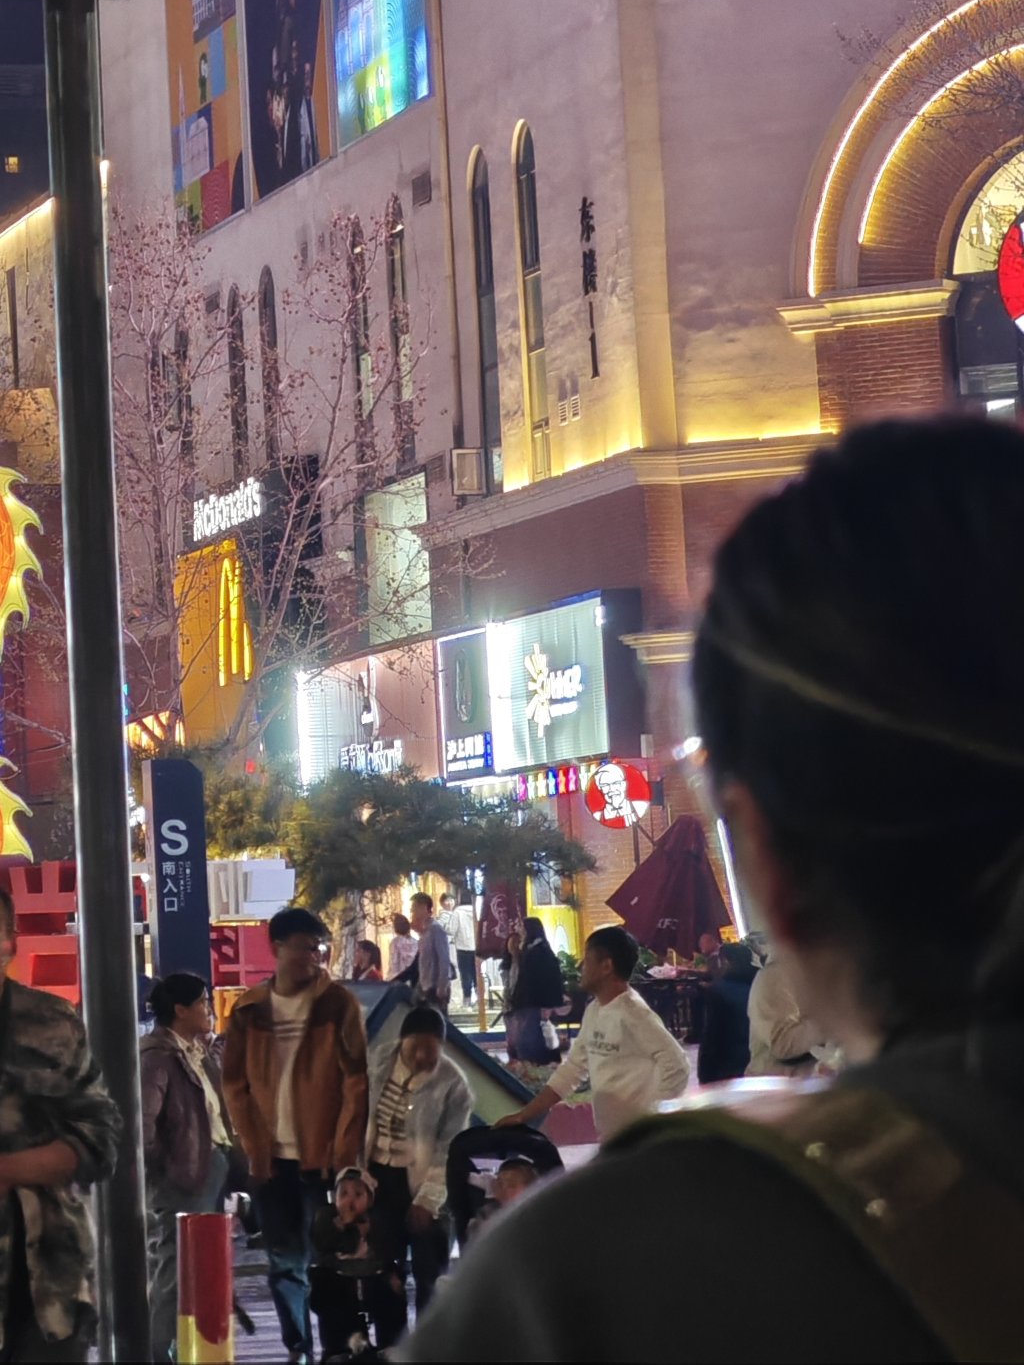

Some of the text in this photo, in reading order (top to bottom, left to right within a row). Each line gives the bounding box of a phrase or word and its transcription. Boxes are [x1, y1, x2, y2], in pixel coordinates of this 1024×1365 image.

[160, 819, 189, 856] S
[162, 860, 179, 913] 南入口
